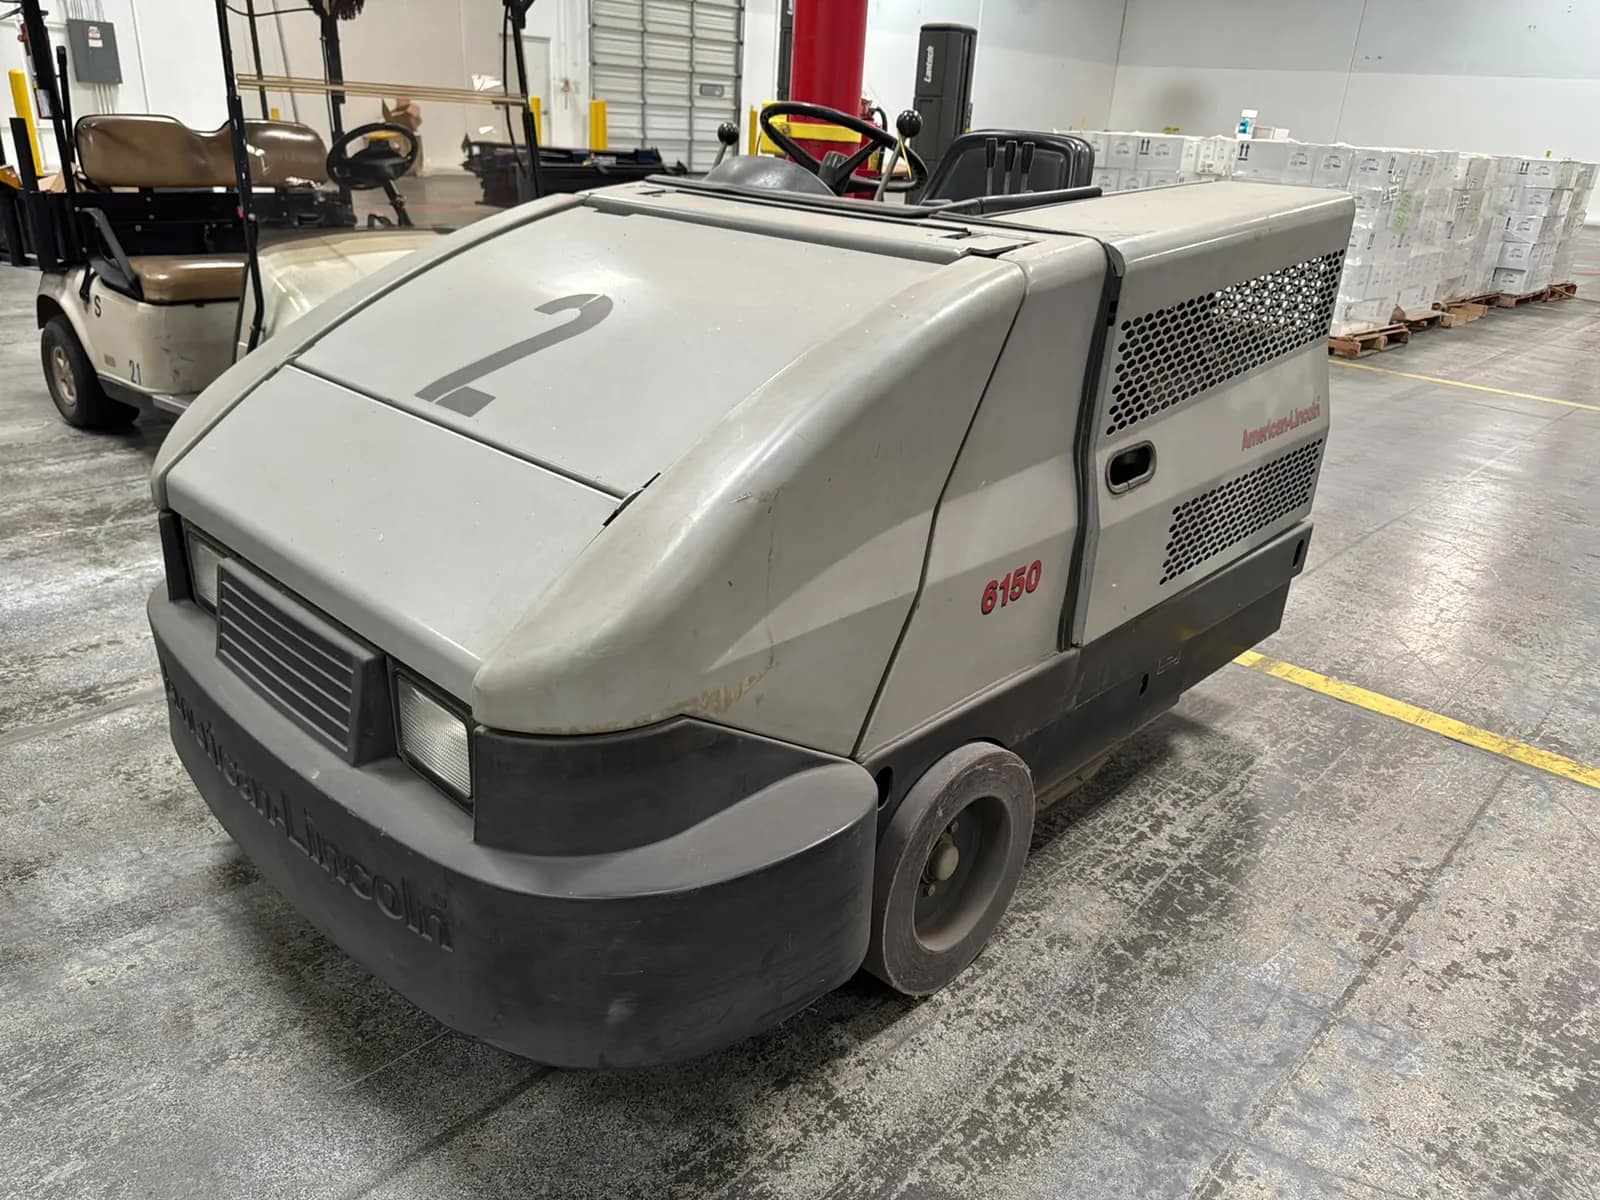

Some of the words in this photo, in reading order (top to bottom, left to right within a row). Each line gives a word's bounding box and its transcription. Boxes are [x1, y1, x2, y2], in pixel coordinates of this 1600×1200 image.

[94, 295, 102, 318] S
[129, 360, 143, 386] 21
[414, 293, 613, 418] 2
[981, 560, 1042, 615] 6150
